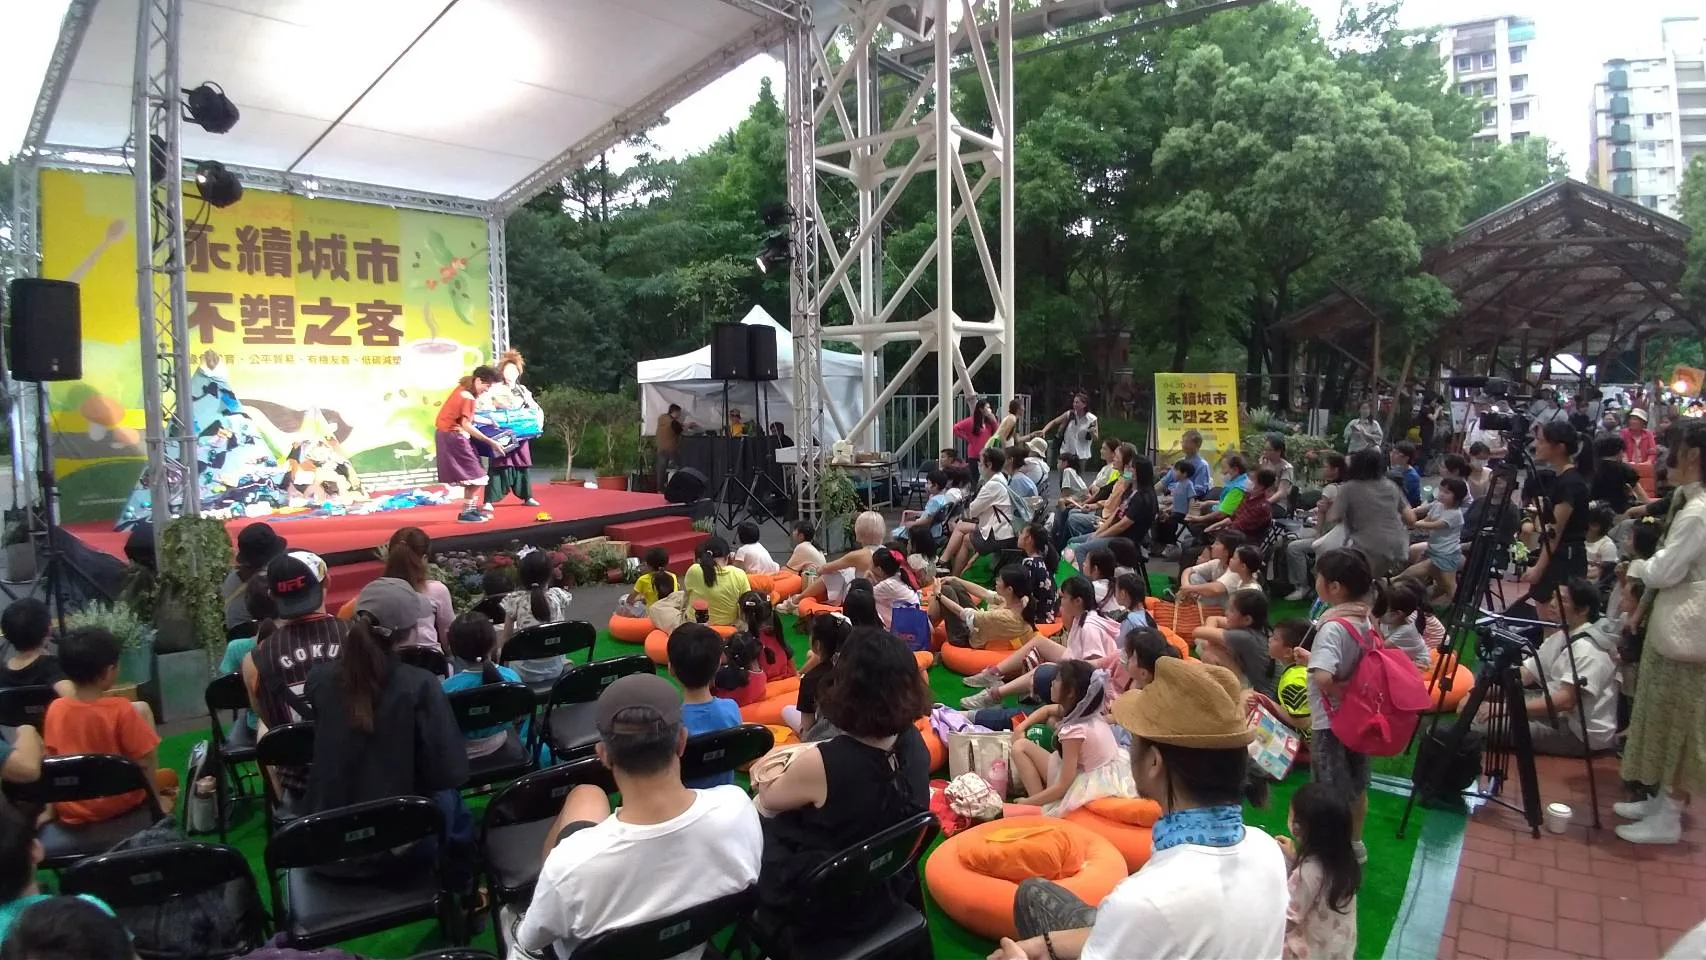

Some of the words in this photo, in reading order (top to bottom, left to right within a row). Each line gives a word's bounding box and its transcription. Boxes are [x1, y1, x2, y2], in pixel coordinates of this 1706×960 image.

[184, 218, 400, 284] 永續城市
[187, 291, 404, 346] 不塑之客
[1167, 392, 1227, 406] 永續城市
[1167, 410, 1229, 424] 不塑之客
[277, 576, 306, 592] UFC
[280, 643, 340, 668] GOKU
